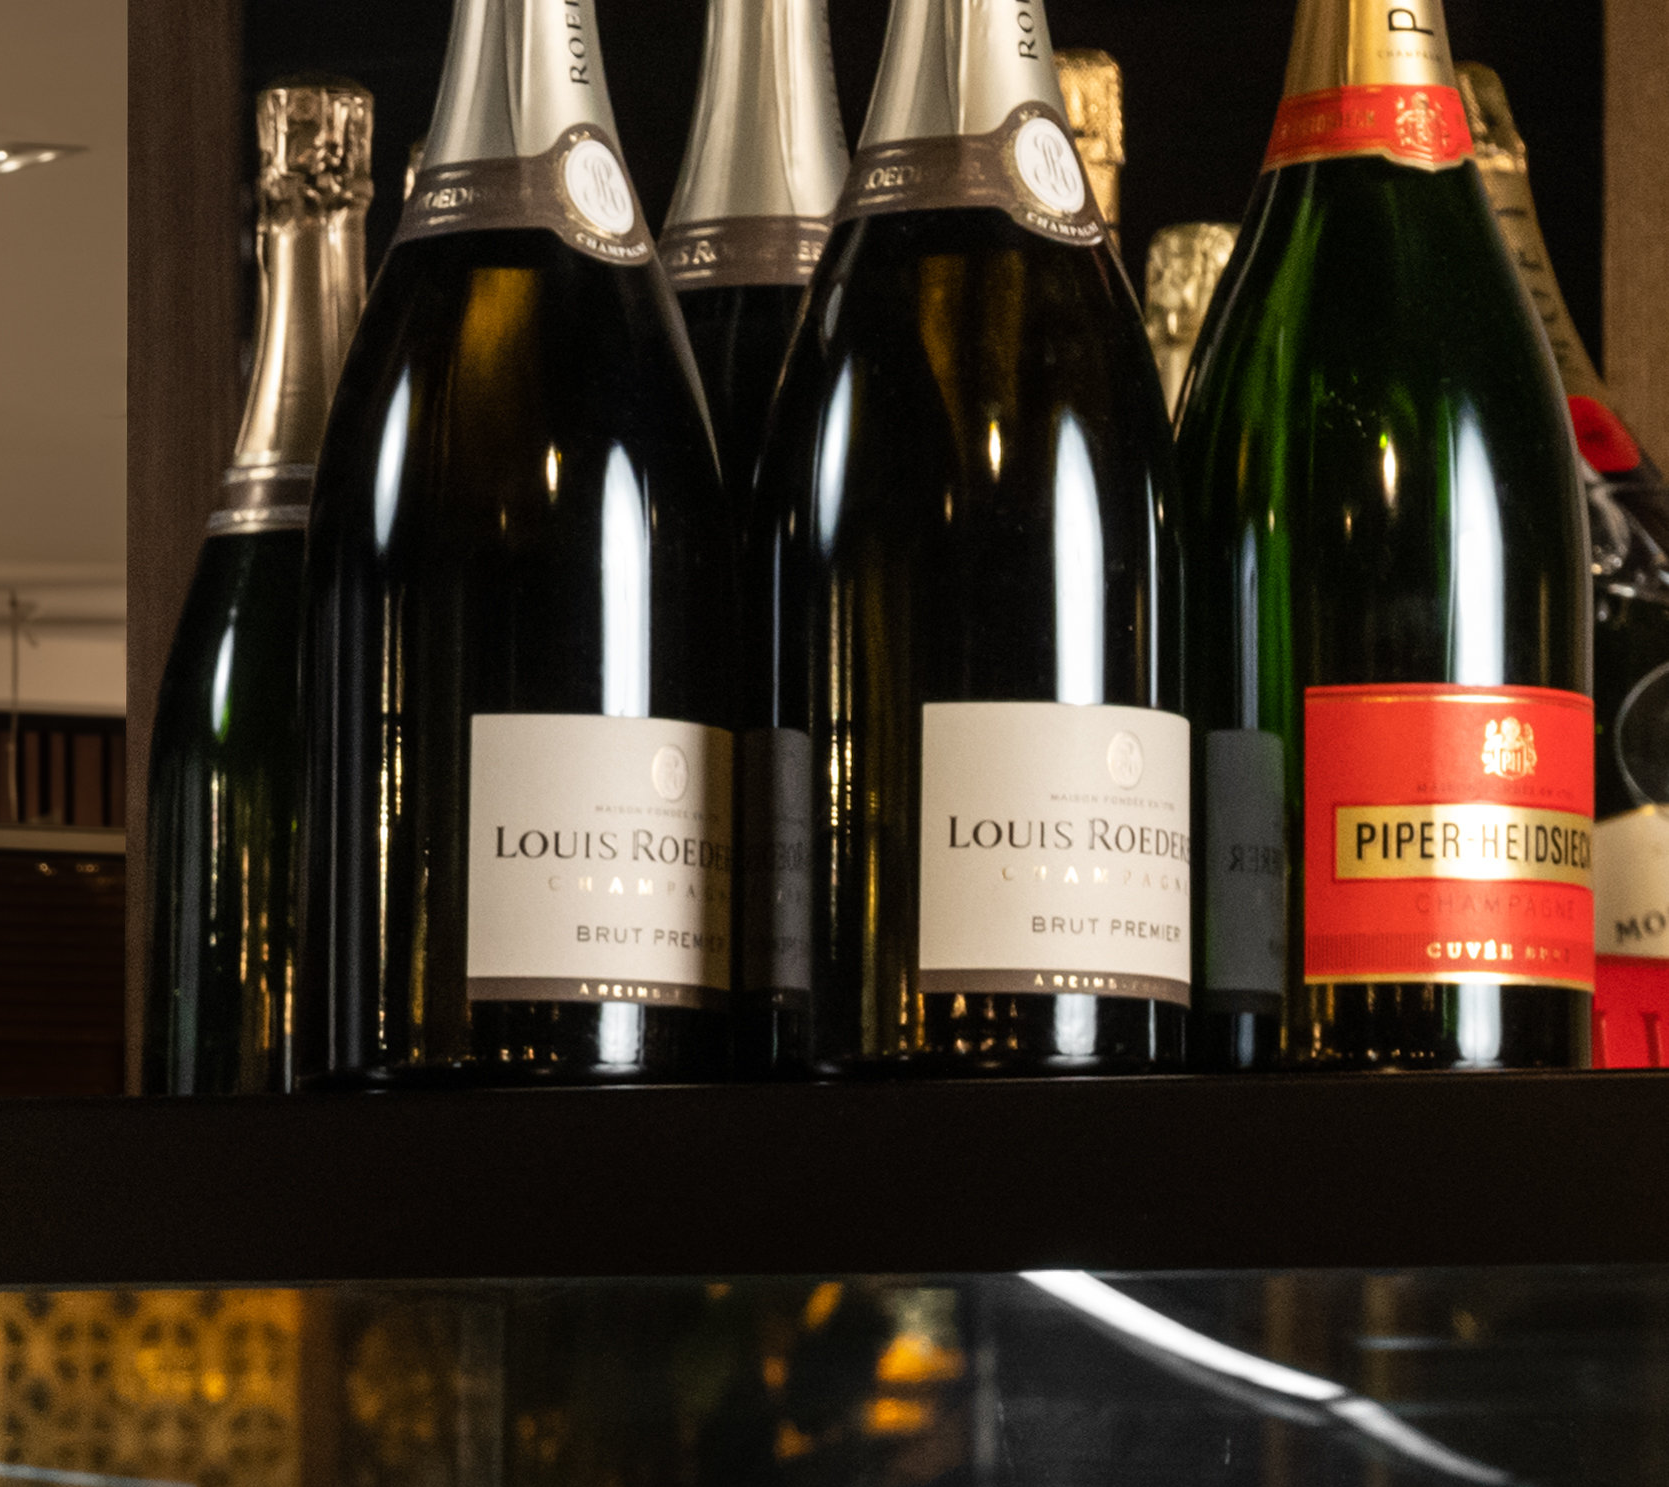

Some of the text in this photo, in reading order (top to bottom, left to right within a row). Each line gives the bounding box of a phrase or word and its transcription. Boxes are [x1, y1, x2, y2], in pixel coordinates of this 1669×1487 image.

[565, 0, 591, 86] ROE
[1016, 0, 1039, 61] RO
[494, 824, 619, 861] LOUIS
[948, 815, 1074, 850] LOUIS
[576, 924, 644, 945] BRUT
[1032, 914, 1182, 944] BRUT PREMIER
[1614, 909, 1666, 944] MO
